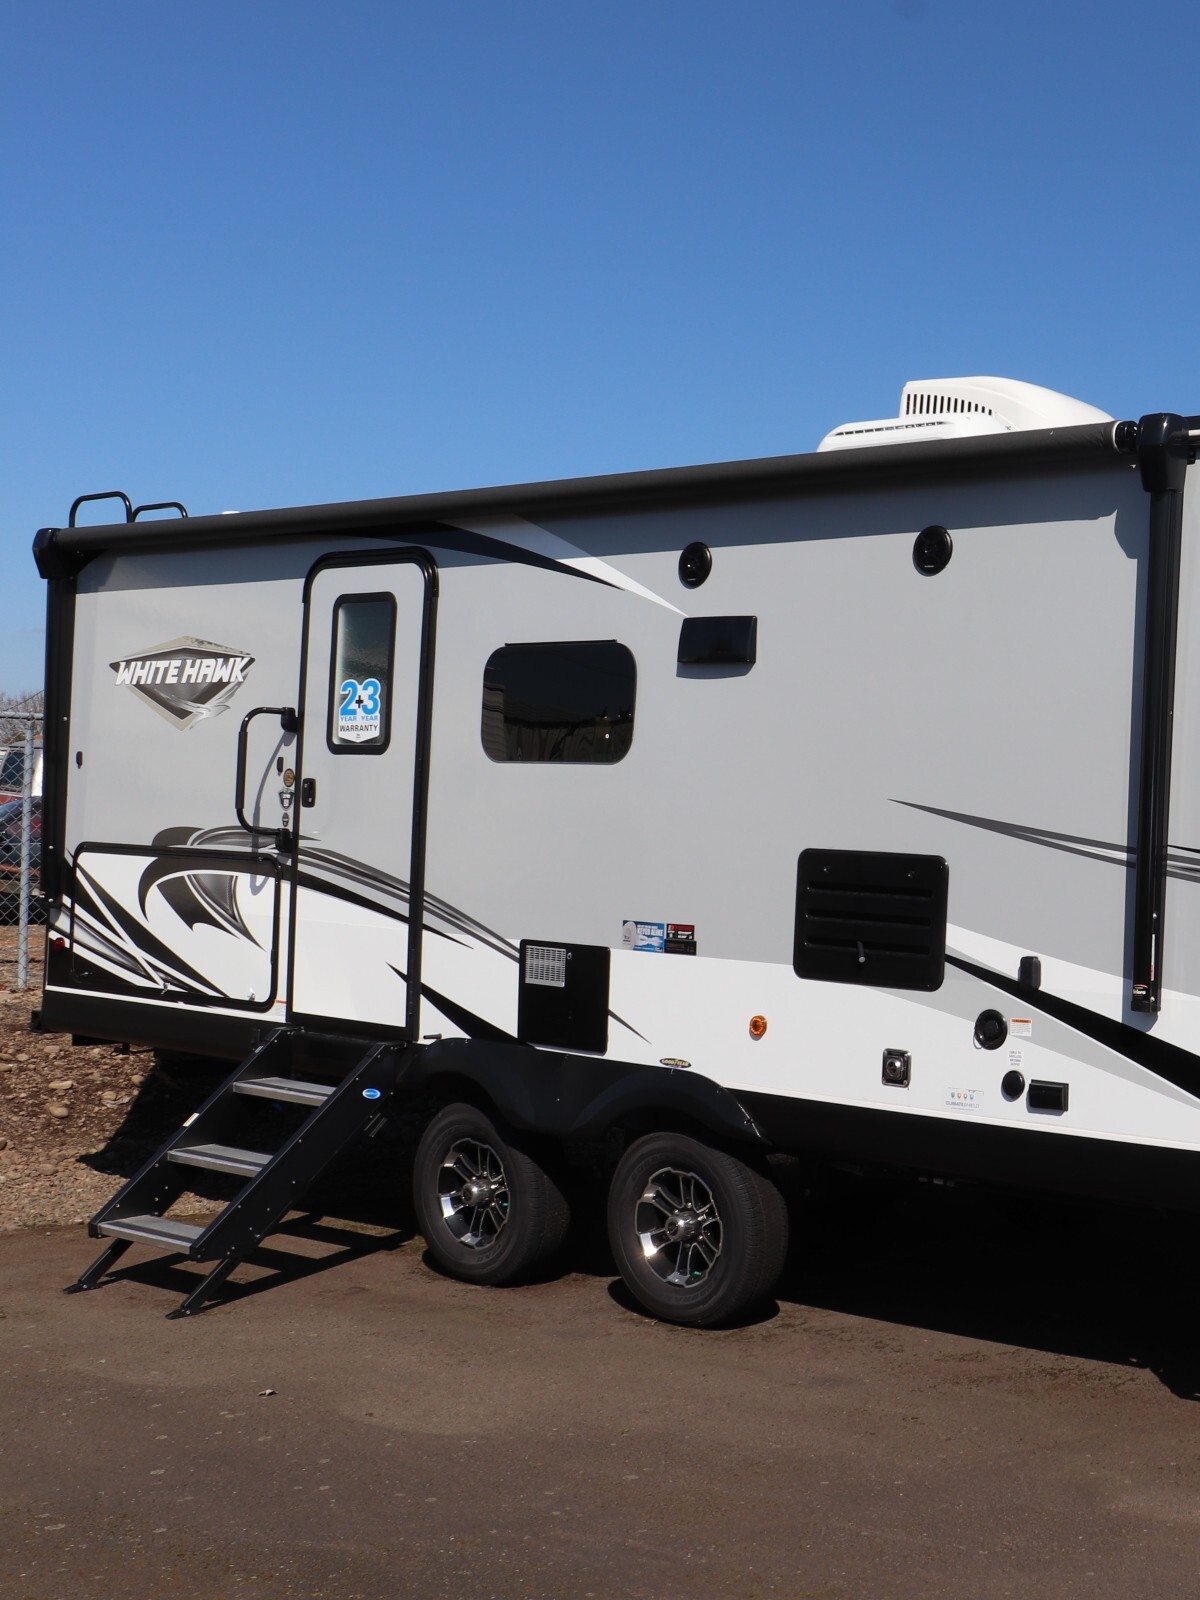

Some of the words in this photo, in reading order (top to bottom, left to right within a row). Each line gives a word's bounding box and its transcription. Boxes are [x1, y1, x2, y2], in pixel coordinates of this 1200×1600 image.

[115, 660, 182, 685] WHITE
[181, 657, 251, 684] HAWK
[340, 724, 379, 732] WARRANTY
